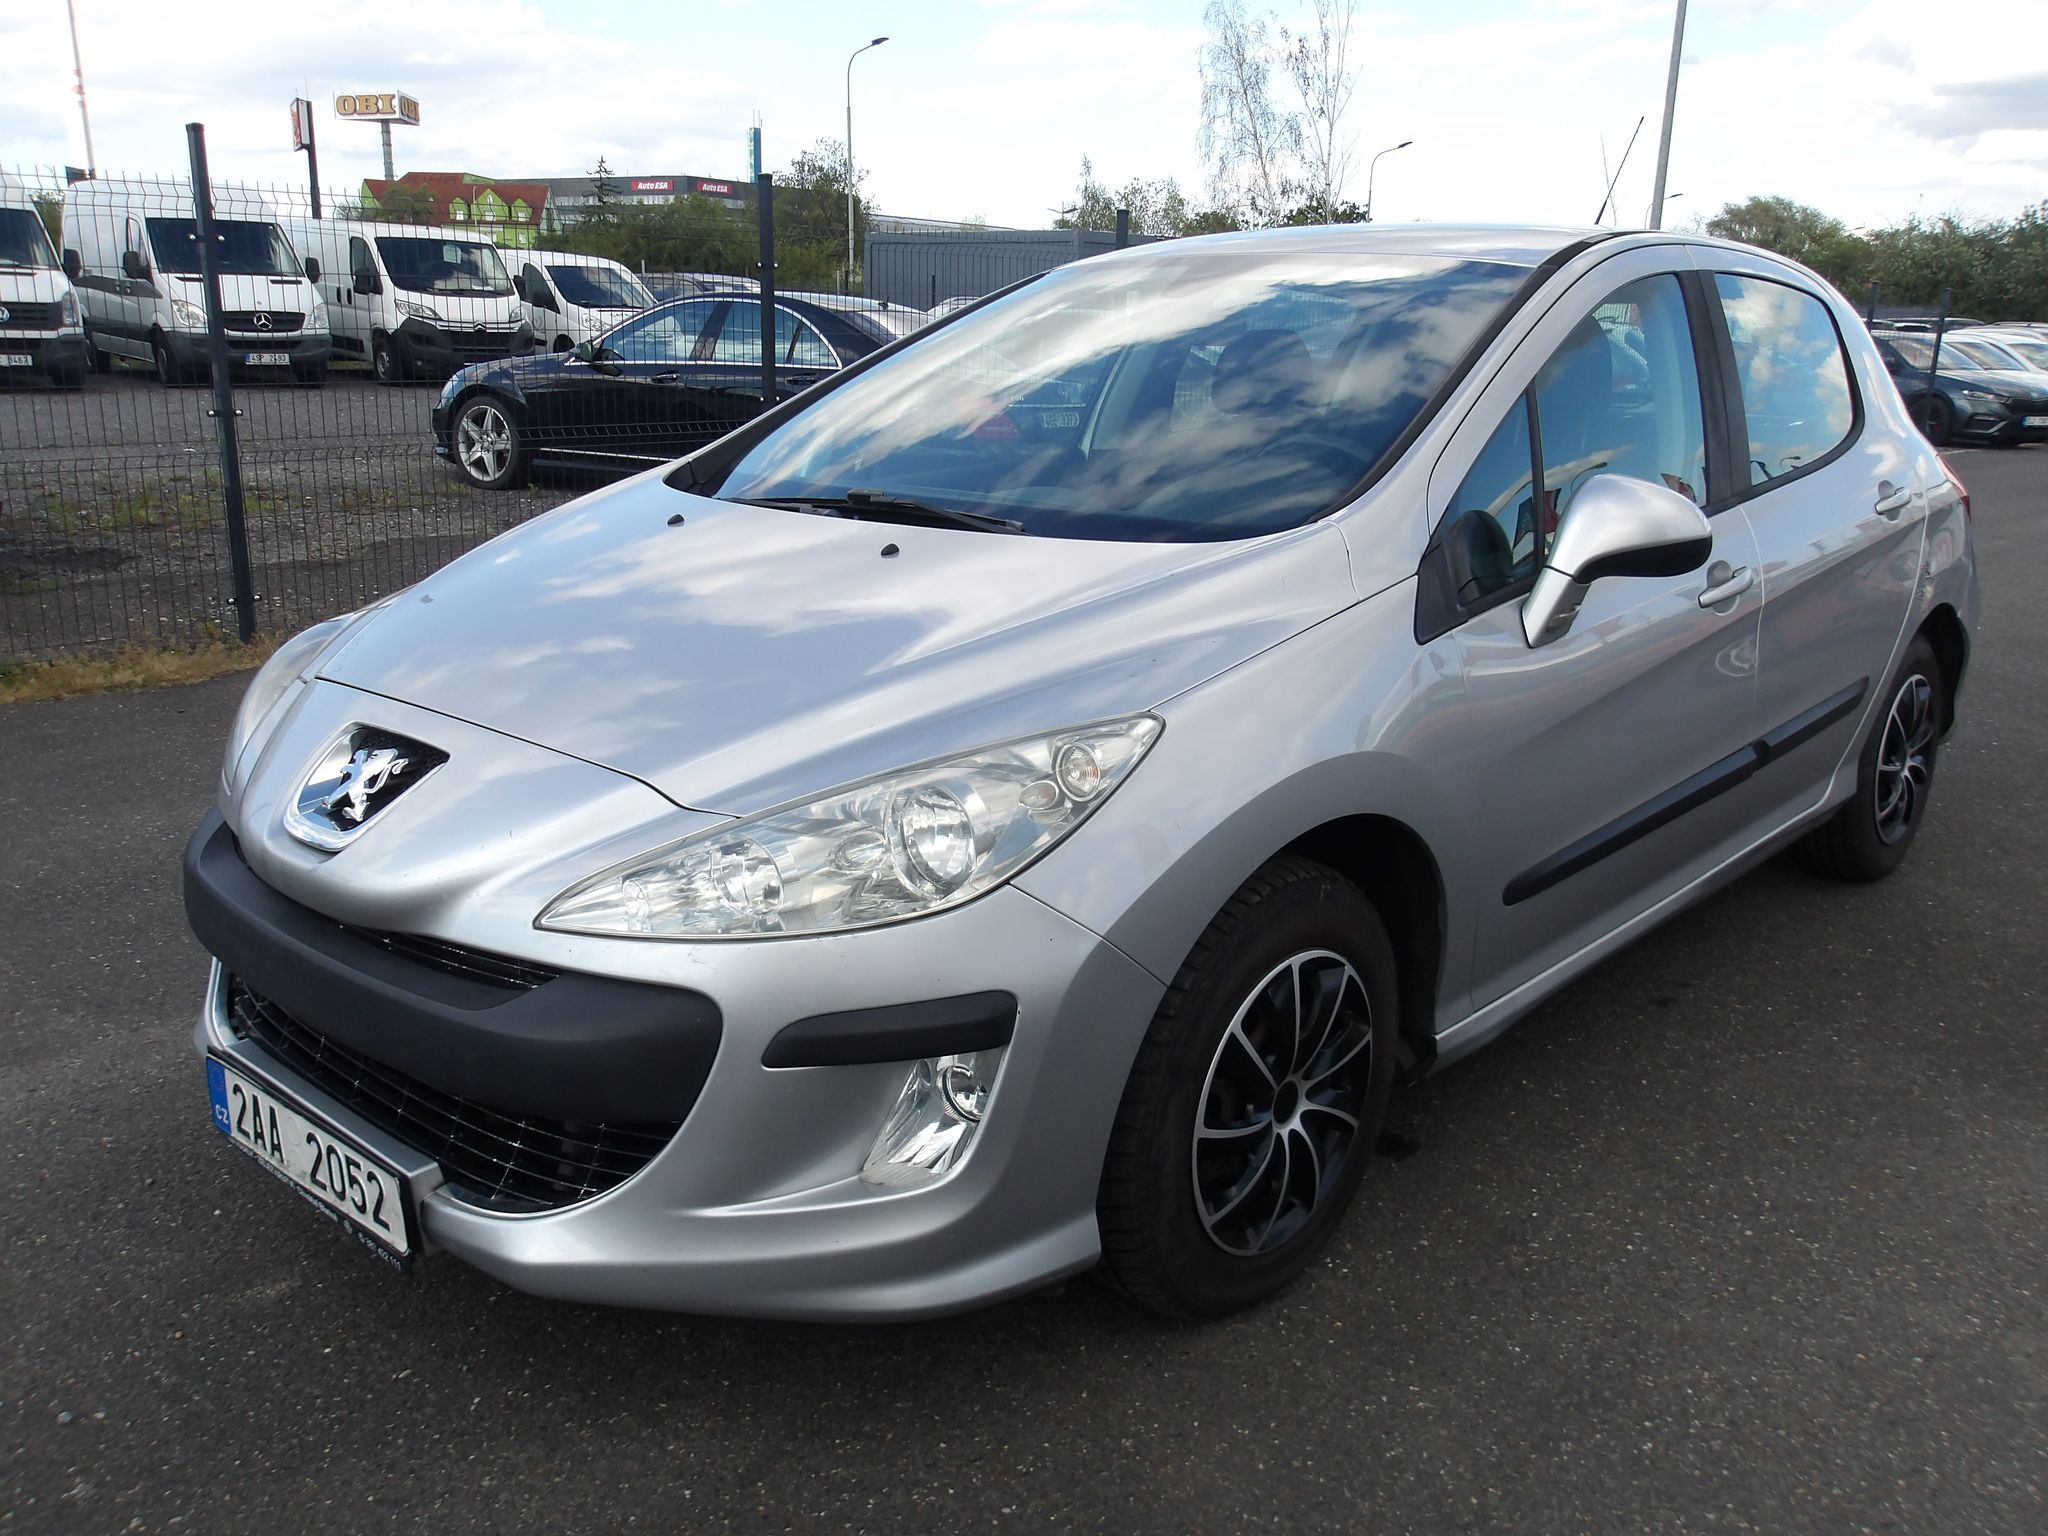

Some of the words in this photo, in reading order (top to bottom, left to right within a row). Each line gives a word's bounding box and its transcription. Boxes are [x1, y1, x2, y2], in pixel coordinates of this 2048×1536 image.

[336, 94, 395, 115] OBI
[401, 96, 419, 121] OBI
[702, 183, 716, 191] Auto
[717, 184, 728, 192] ESA
[215, 1104, 229, 1124] CZ
[232, 1083, 286, 1165] 2AA
[306, 1131, 392, 1233] 2052
